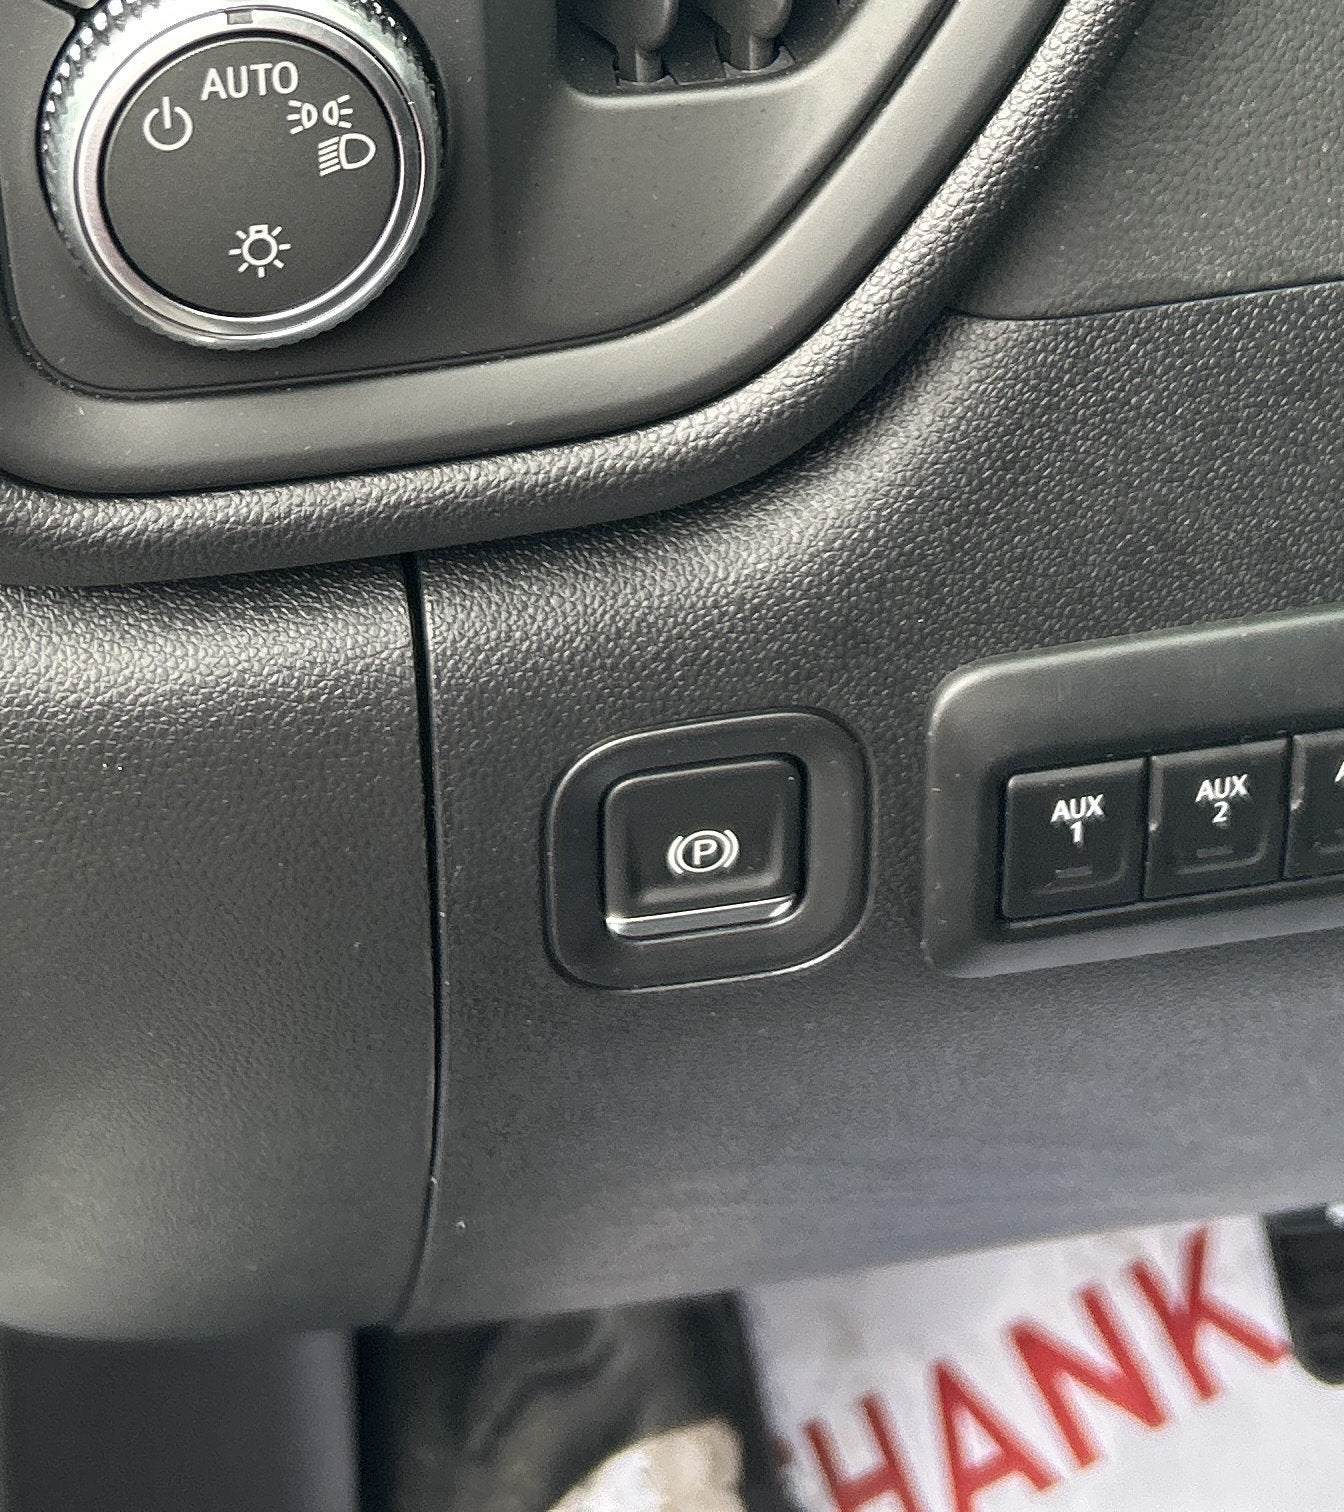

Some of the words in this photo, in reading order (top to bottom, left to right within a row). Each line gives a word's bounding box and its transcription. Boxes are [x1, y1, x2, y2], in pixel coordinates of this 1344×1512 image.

[200, 60, 299, 101] AUTO
[1195, 773, 1251, 802] AUX
[1050, 793, 1106, 823] AUX
[1211, 801, 1229, 824] 2
[1068, 822, 1085, 844] 1
[776, 1226, 1290, 1512] HANK
